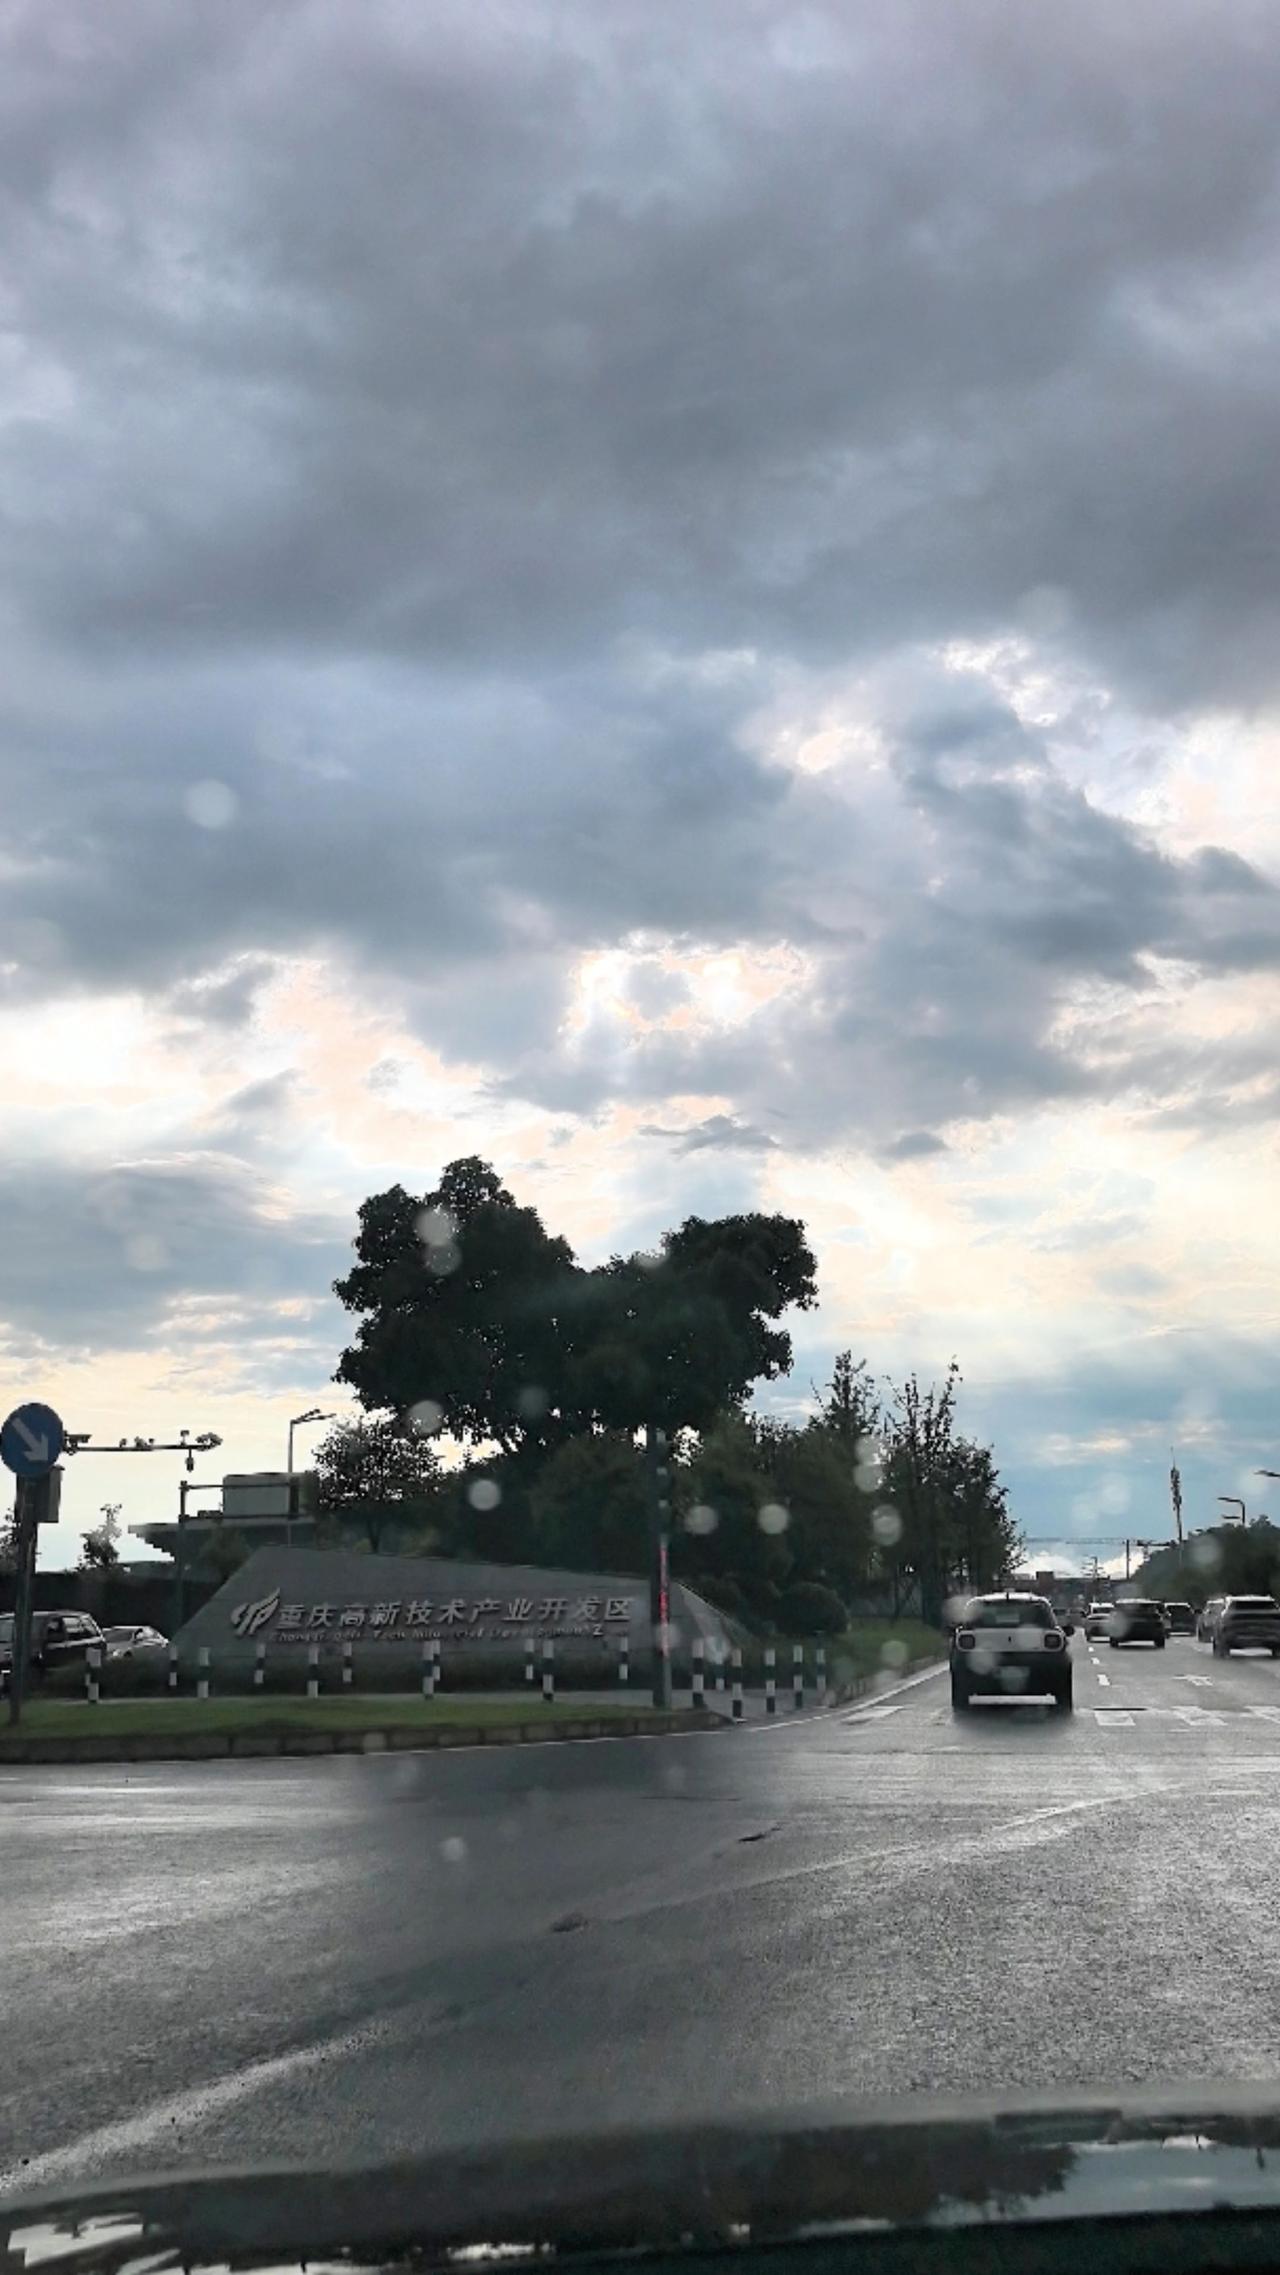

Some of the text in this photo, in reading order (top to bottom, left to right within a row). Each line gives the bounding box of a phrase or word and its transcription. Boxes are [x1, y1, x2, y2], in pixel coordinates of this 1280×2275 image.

[275, 1597, 635, 1628] 重庆高新技术产业开发区
